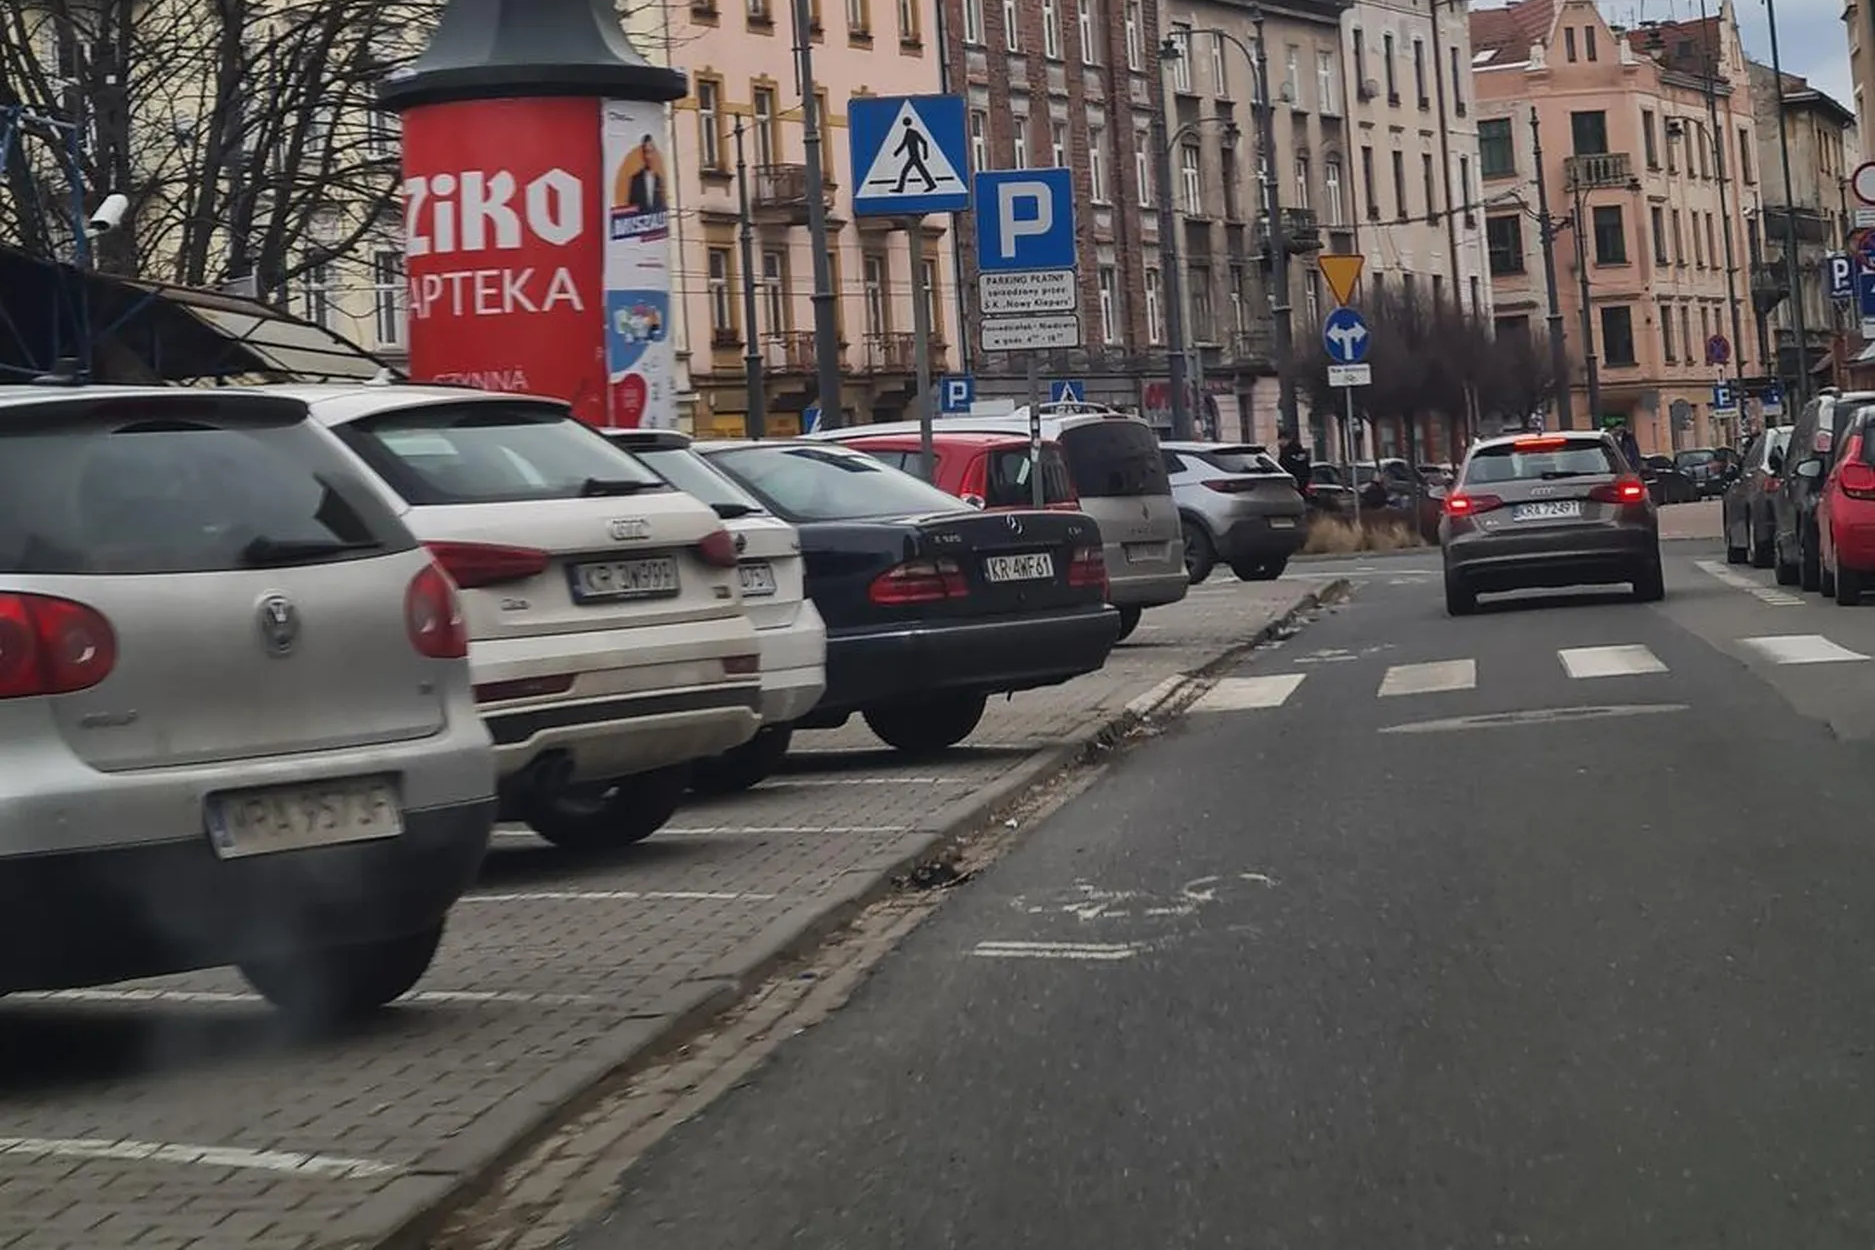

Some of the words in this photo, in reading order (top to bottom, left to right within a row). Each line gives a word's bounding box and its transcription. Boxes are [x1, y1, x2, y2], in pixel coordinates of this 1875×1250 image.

[998, 181, 1053, 258] P
[986, 276, 1028, 286] PARKING
[1834, 259, 1849, 289] P
[408, 266, 584, 320] APTEKA
[949, 381, 968, 409] P
[990, 558, 1010, 581] KR
[1013, 554, 1051, 579] 4WF61
